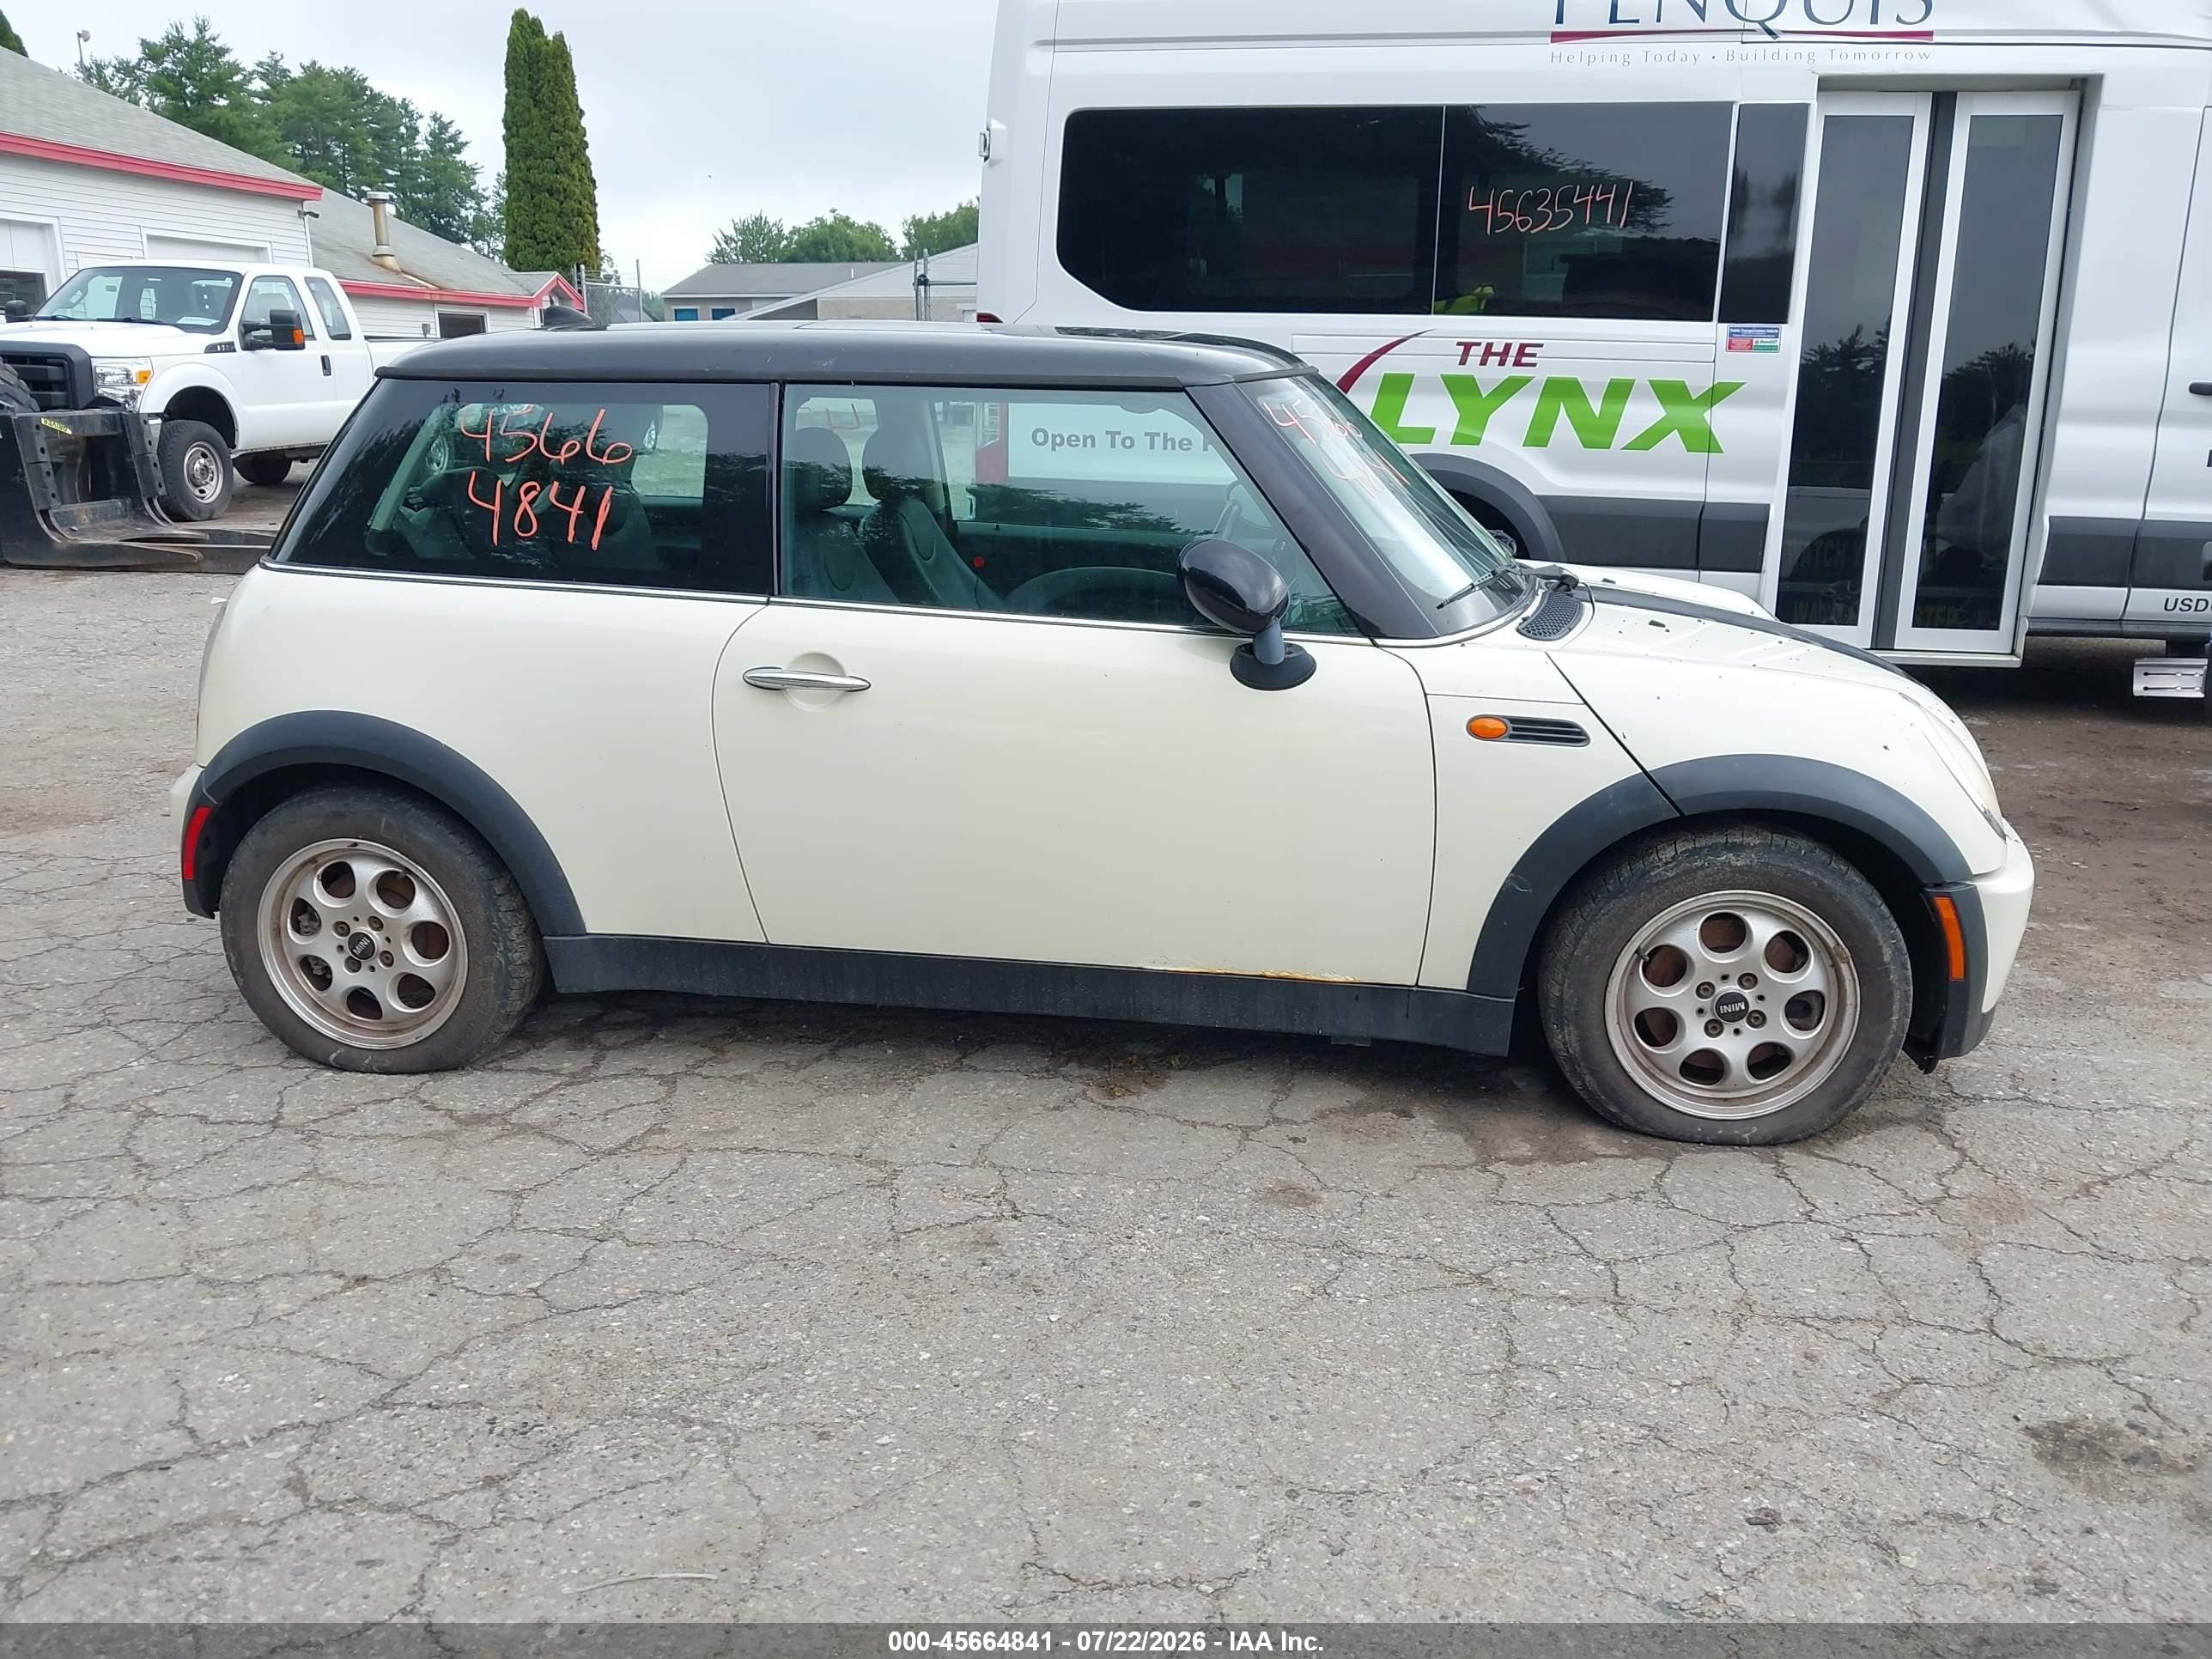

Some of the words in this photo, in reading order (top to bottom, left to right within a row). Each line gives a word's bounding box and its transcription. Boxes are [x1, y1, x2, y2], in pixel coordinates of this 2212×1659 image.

[1551, 50, 1632, 67] Helping
[1642, 50, 1702, 64] Today
[1726, 49, 1816, 64] Building
[1827, 49, 1931, 62] Tomorrow
[1468, 179, 1633, 235] 45635441
[1455, 341, 1545, 368] THE
[1370, 372, 1747, 454] LYNX
[460, 404, 634, 466] 4566
[1031, 428, 1097, 452] Open
[1105, 429, 1136, 451] To
[1144, 430, 1193, 453] The
[468, 470, 614, 550] 4841
[2163, 597, 2212, 612] USD
[353, 937, 371, 956] MINI
[1720, 1001, 1746, 1014] MINI
